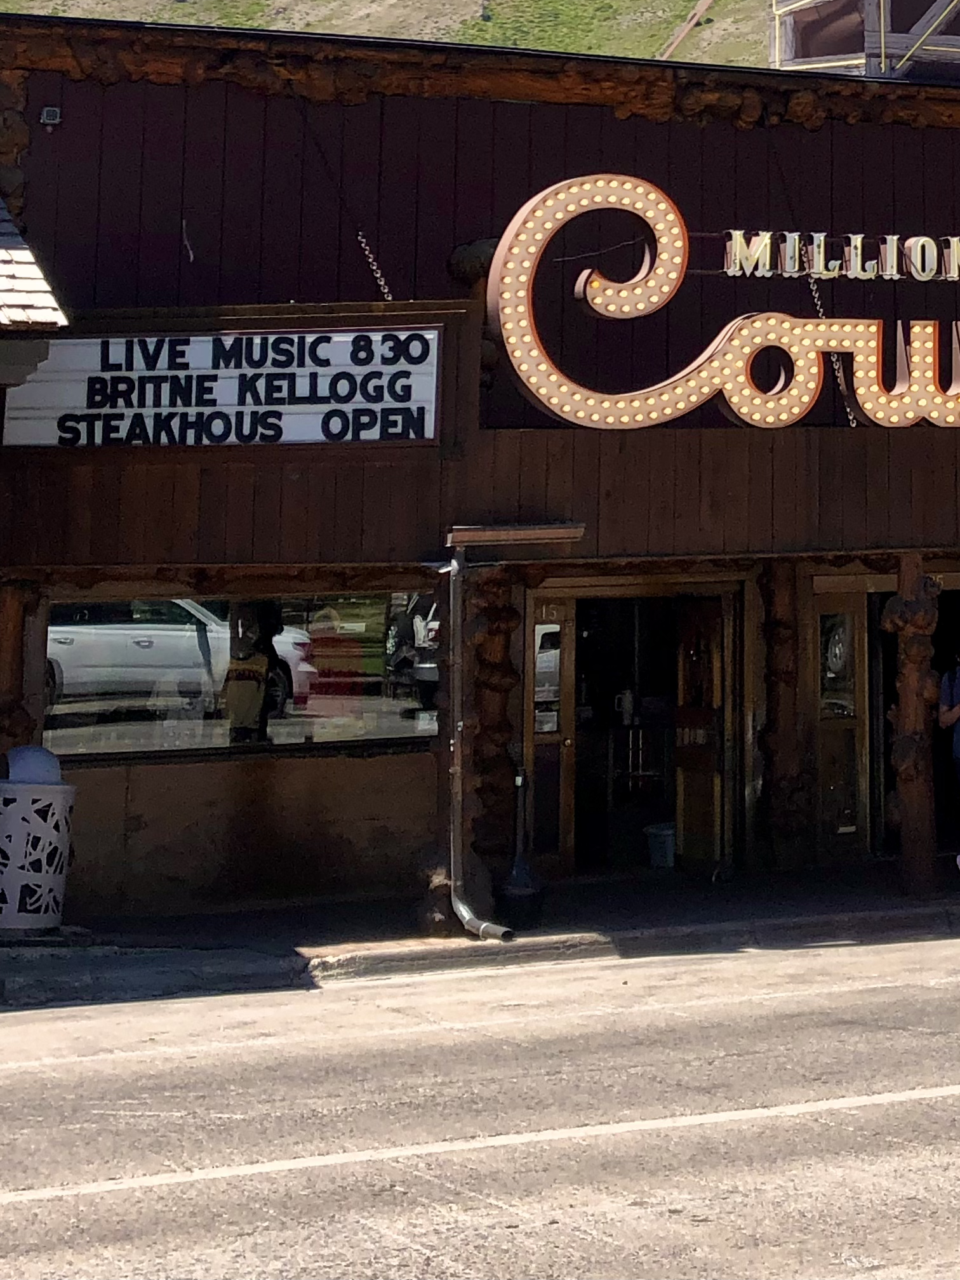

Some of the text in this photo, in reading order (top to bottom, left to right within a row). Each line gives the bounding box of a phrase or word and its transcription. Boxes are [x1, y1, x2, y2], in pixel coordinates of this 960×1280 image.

[101, 332, 431, 373] LIVE MUSIC 830
[86, 370, 413, 410] BRITNE KELLOGG
[57, 406, 426, 448] STEAKHOUS OPEN
